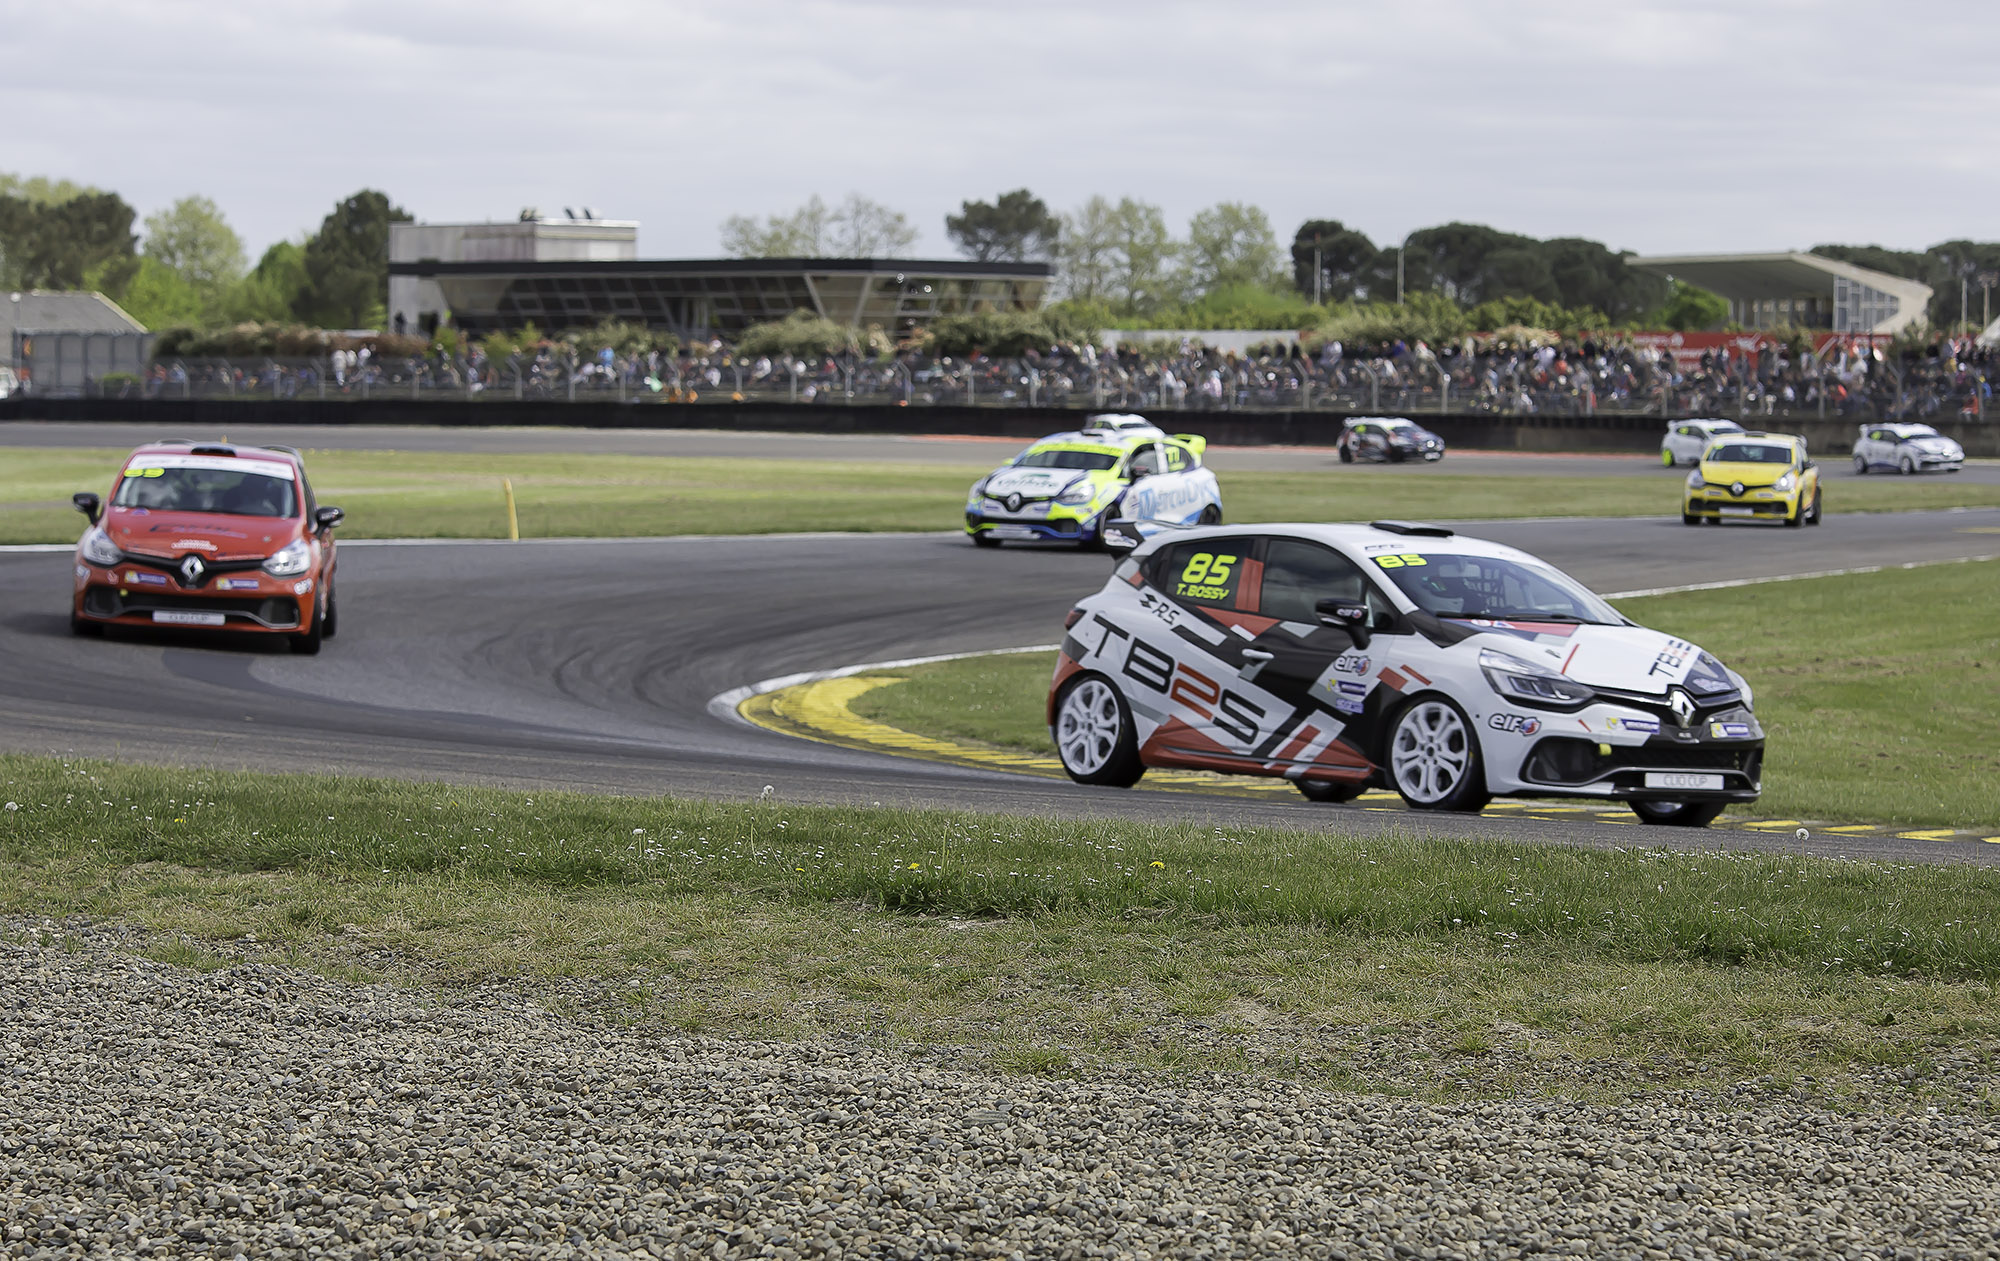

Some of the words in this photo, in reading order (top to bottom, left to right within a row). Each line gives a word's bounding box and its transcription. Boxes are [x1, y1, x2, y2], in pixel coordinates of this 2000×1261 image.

[1182, 553, 1237, 586] 85
[1375, 554, 1428, 568] 85
[1176, 583, 1230, 600] T.BOSSY
[1093, 614, 1266, 746] TB2S
[1488, 713, 1525, 732] elf
[1663, 774, 1686, 786] CLIO
[1688, 774, 1708, 787] CUP
